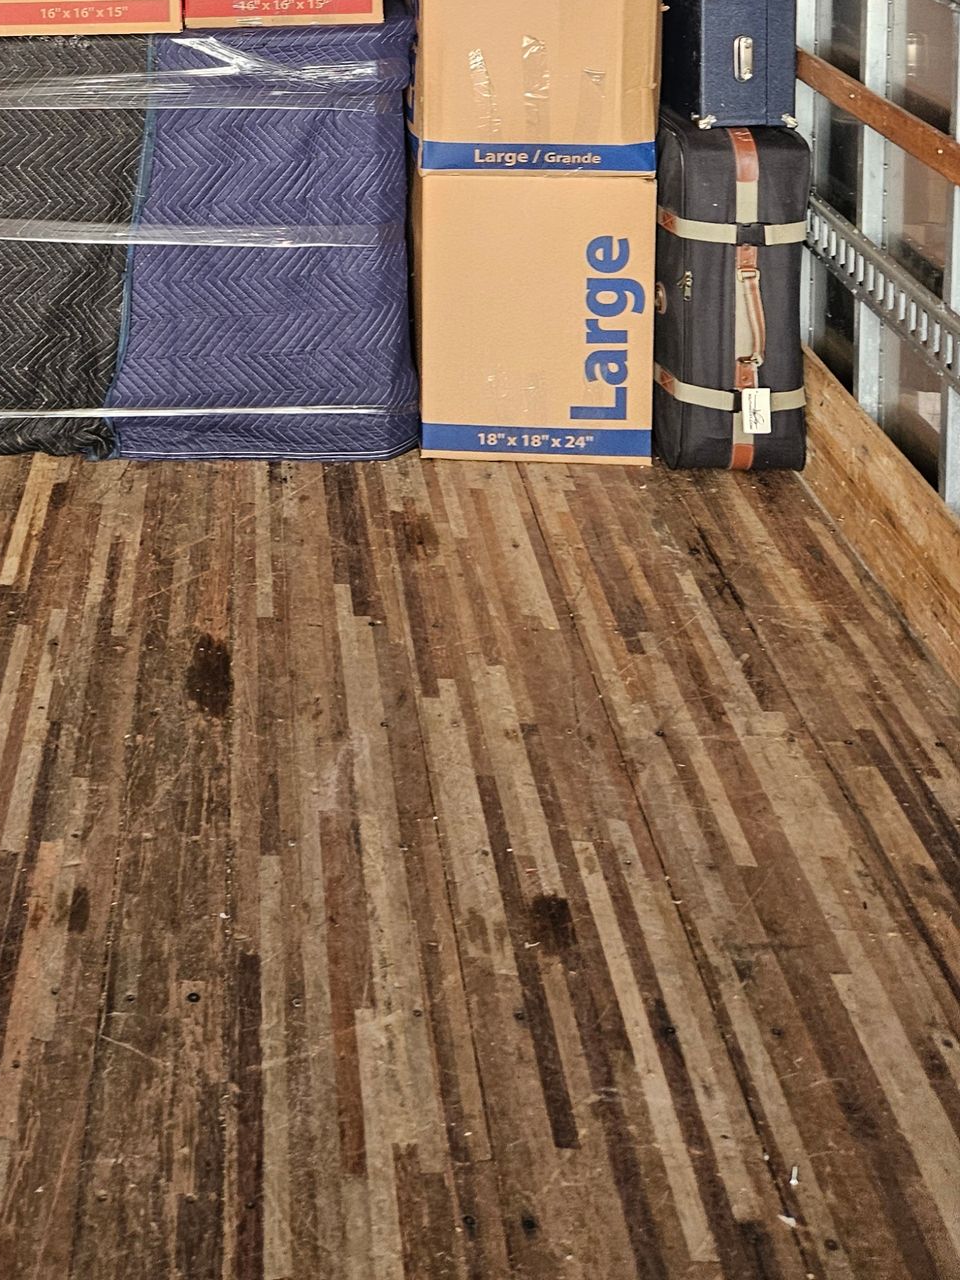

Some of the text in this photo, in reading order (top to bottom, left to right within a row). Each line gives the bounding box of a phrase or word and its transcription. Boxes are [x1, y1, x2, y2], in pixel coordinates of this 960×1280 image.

[40, 6, 129, 19] 16" x 16" x 15"
[239, 0, 260, 11] 16"
[262, 2, 270, 10] x
[273, 0, 295, 10] 16"
[296, 0, 305, 9] x
[474, 149, 601, 166] Large / Grande
[570, 235, 646, 420] Large
[477, 433, 594, 448] 18" x 18" x 24"
